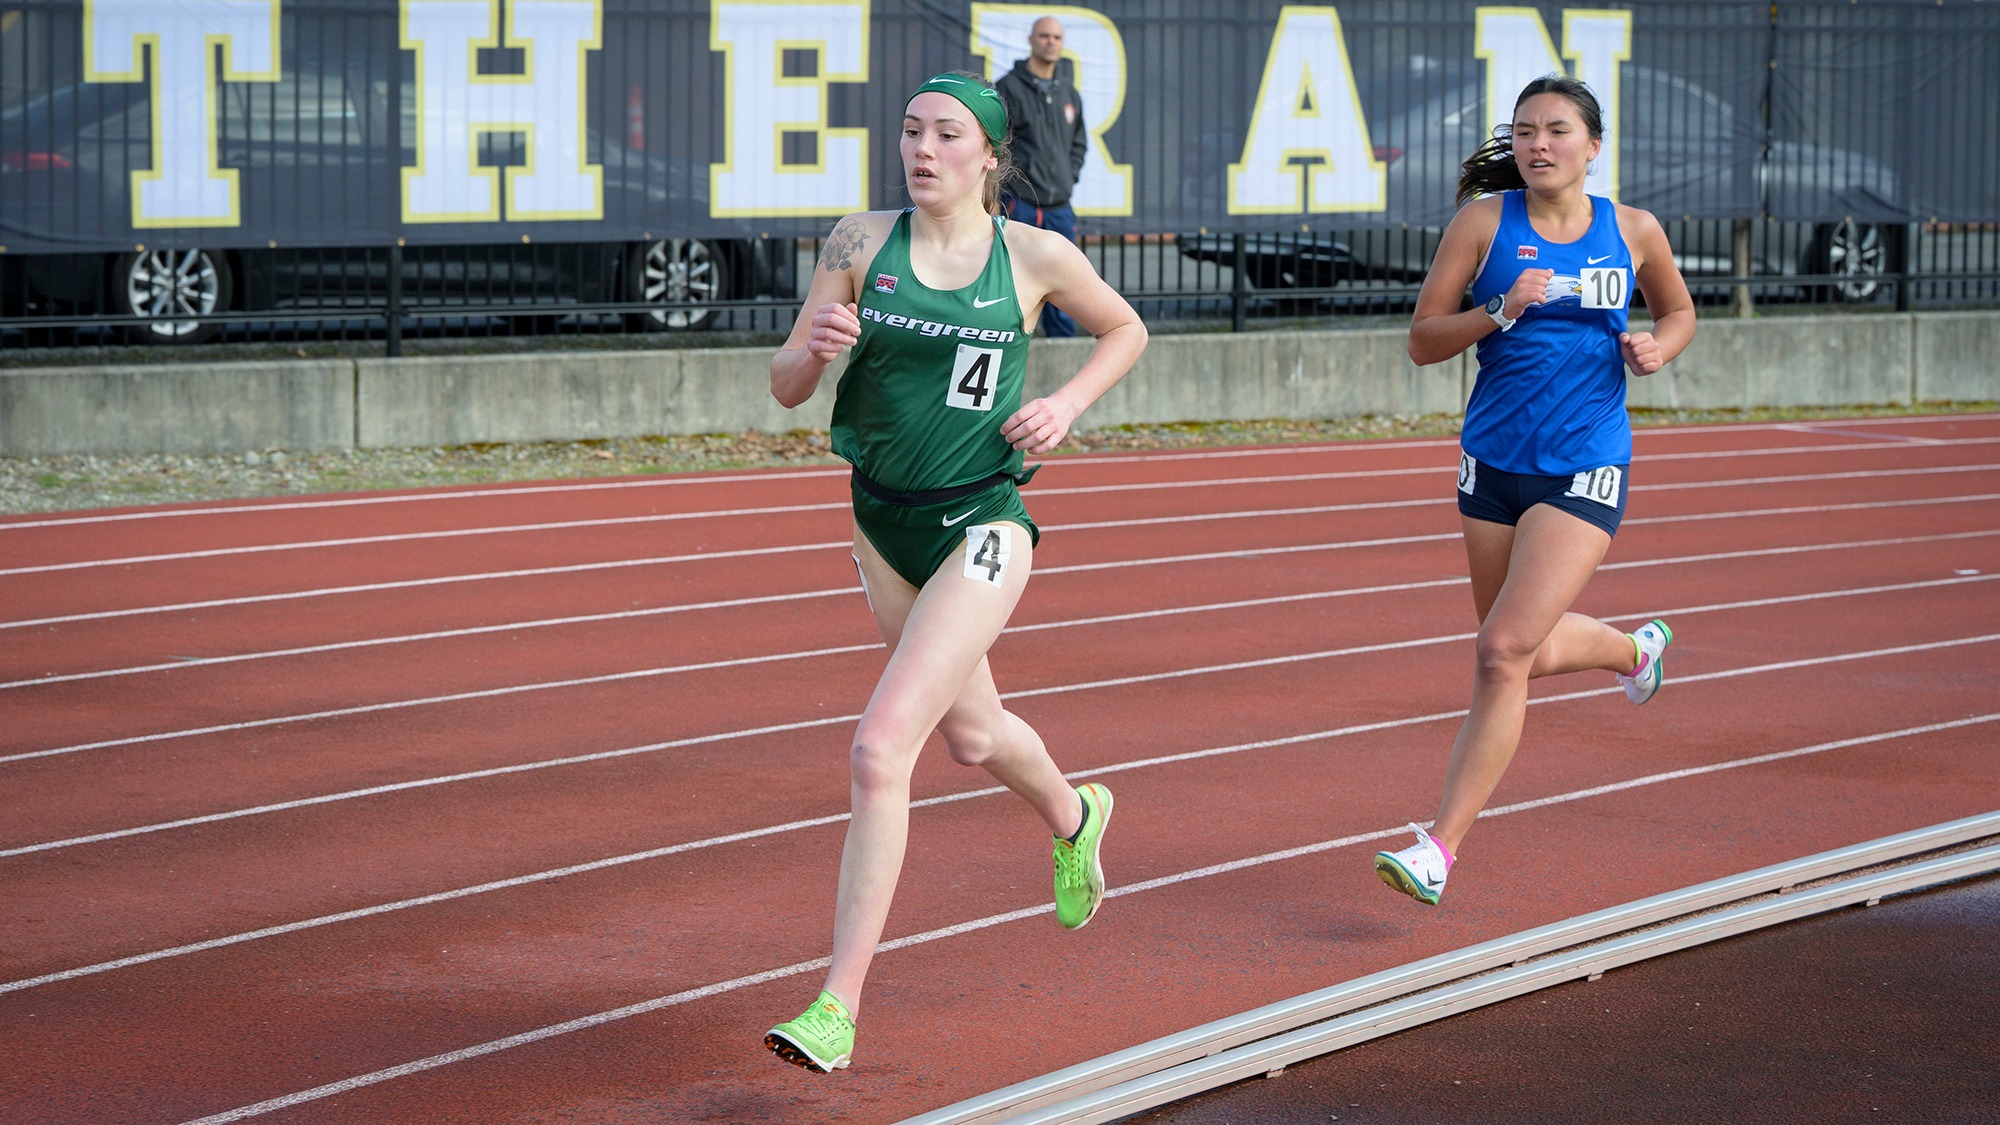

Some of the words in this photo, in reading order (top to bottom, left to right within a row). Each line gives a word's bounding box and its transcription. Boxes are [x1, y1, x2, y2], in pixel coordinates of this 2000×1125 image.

[1590, 269, 1621, 307] 10
[861, 307, 1016, 343] evergreen
[957, 352, 992, 407] 4
[1584, 465, 1615, 501] 10
[973, 529, 1002, 582] 4
